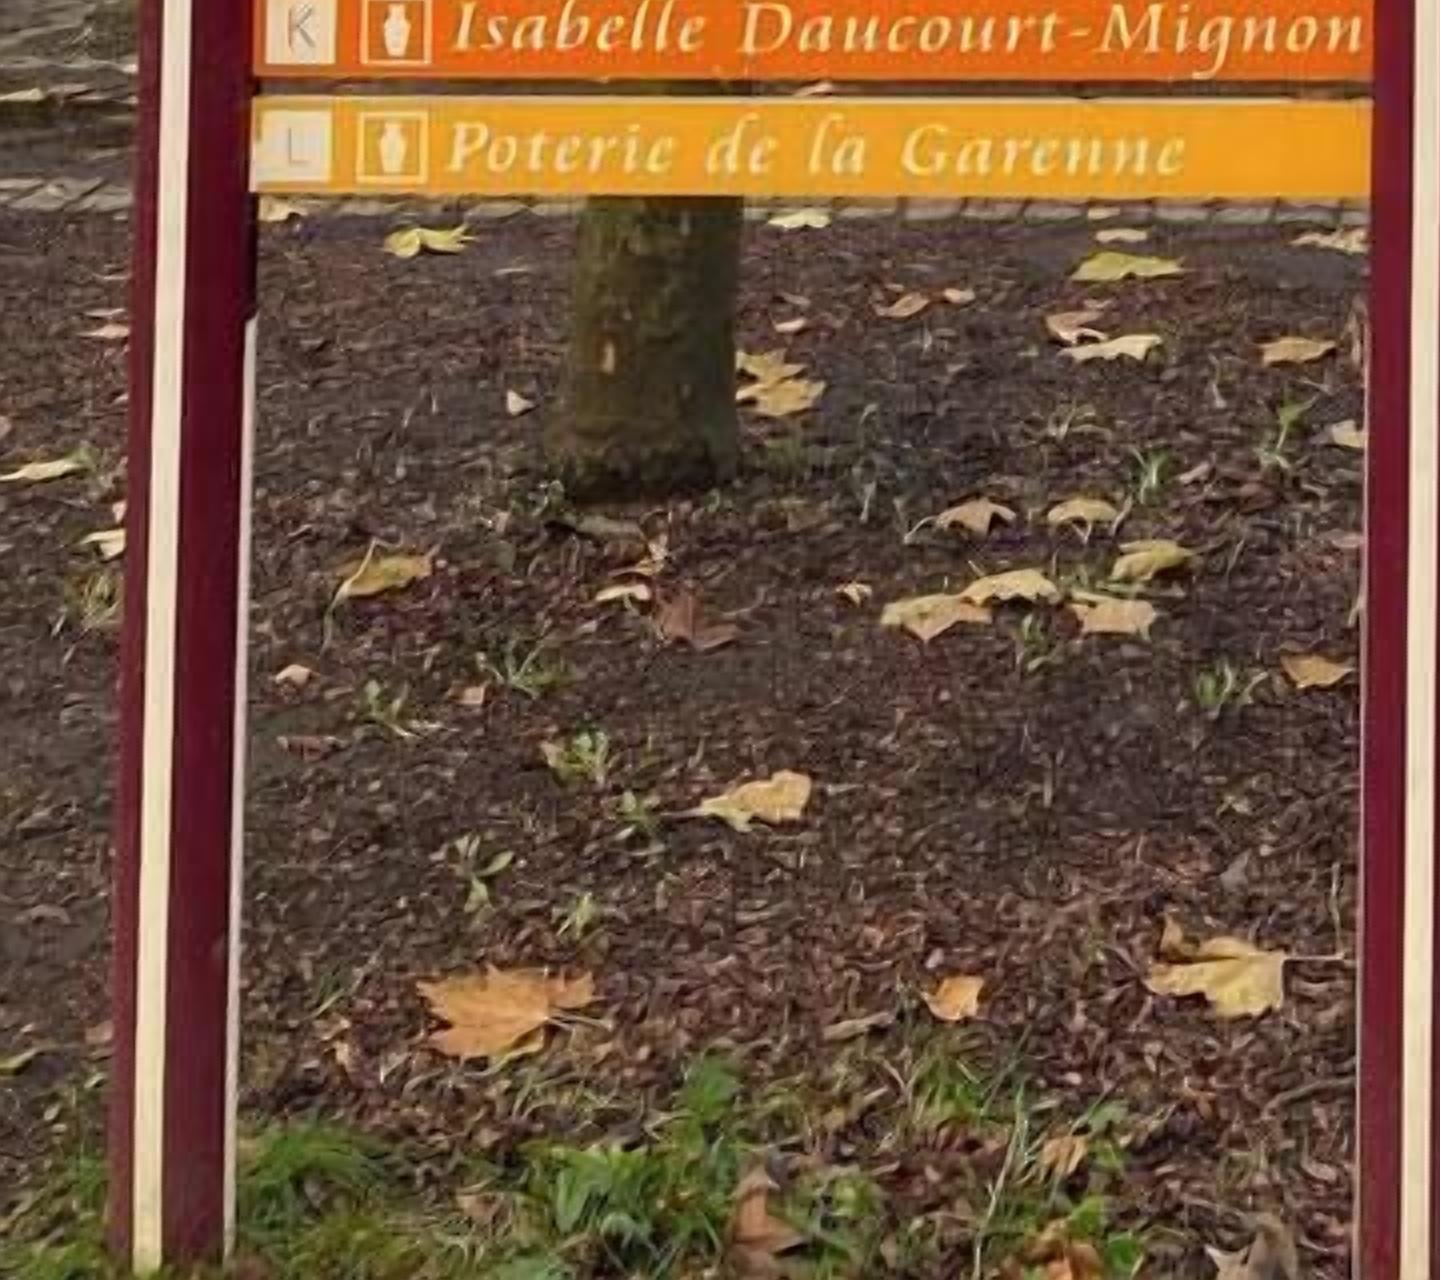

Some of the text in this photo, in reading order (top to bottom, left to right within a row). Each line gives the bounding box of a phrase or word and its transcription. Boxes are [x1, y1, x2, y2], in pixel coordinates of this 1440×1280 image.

[287, 4, 317, 49] K
[739, 1, 1363, 80] Daucourt-Mignon
[447, 120, 673, 173] Poterie
[704, 113, 776, 175] de
[808, 113, 866, 175] la
[902, 123, 1186, 177] Garenne
